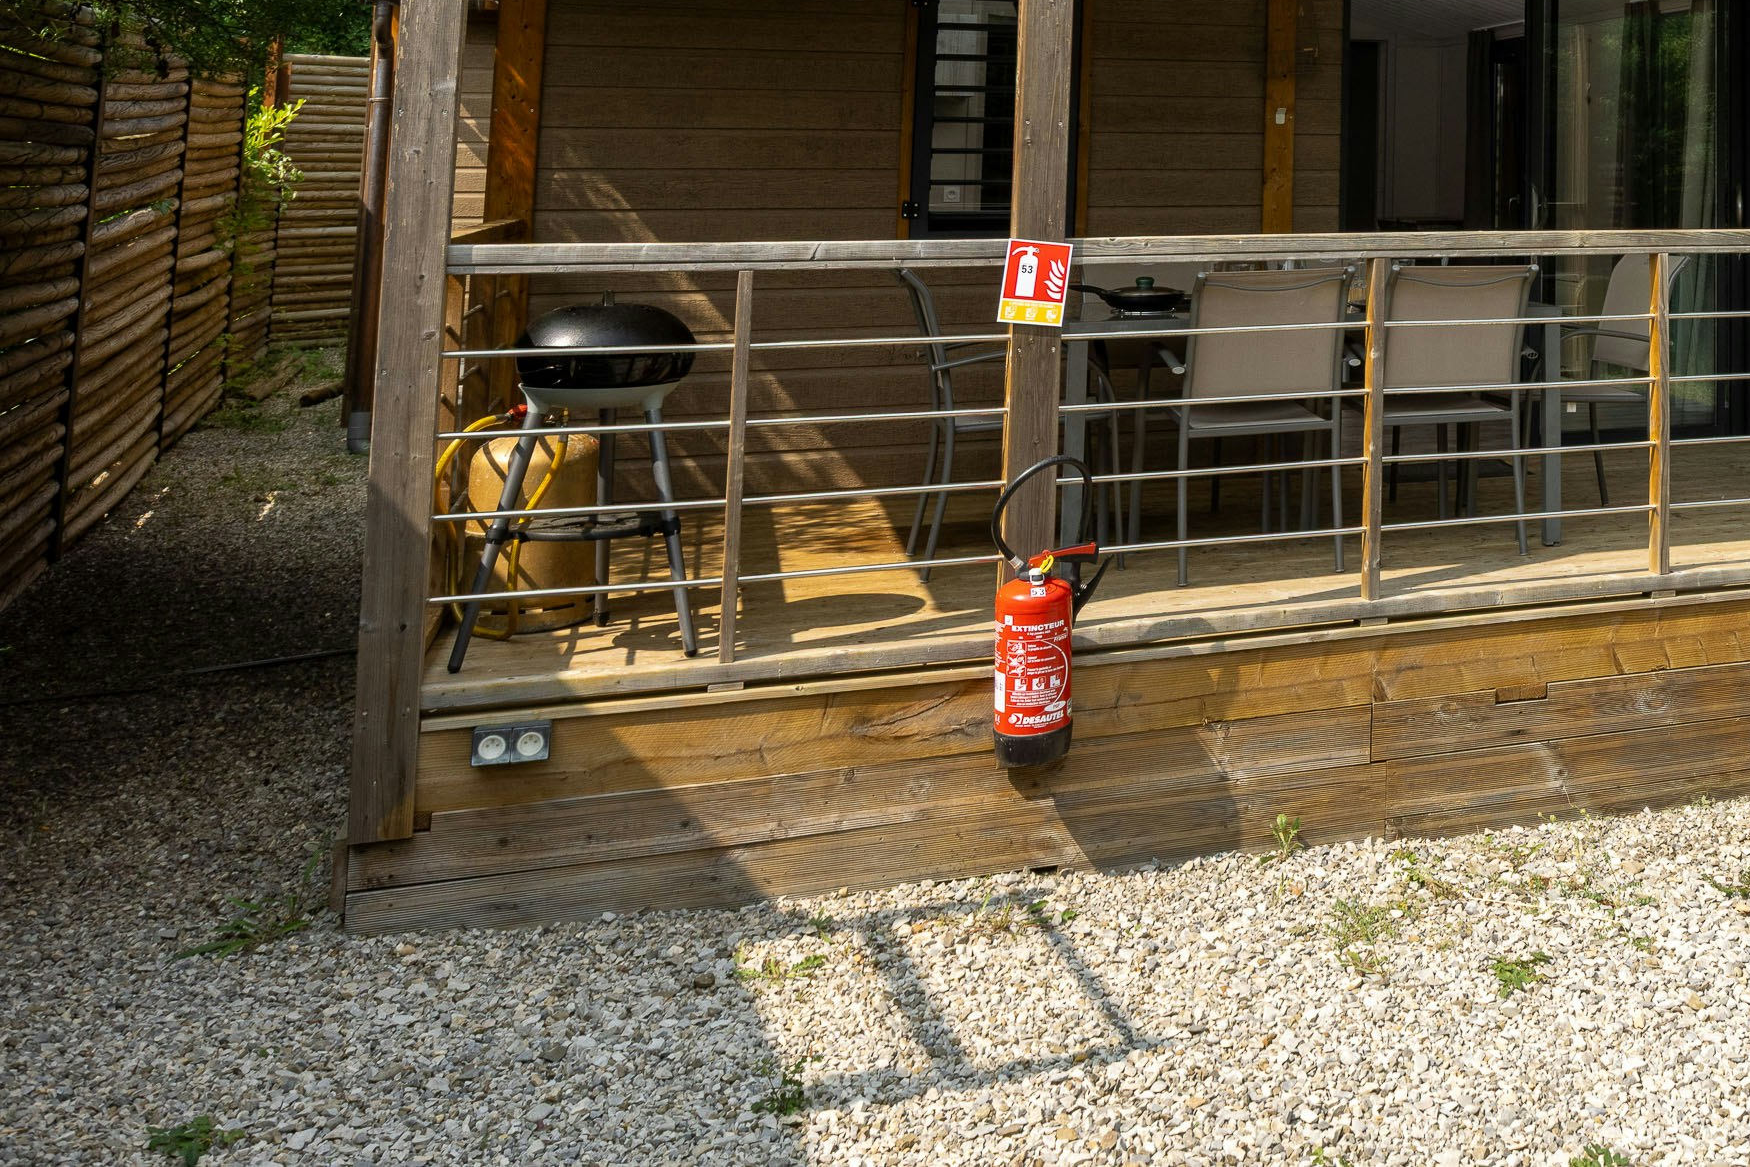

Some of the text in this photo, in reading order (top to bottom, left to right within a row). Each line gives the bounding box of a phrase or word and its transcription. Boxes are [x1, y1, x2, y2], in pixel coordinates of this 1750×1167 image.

[1022, 264, 1034, 274] 53
[1011, 619, 1065, 632] EXTINCTEUR
[1022, 709, 1065, 725] DESAUTEL
